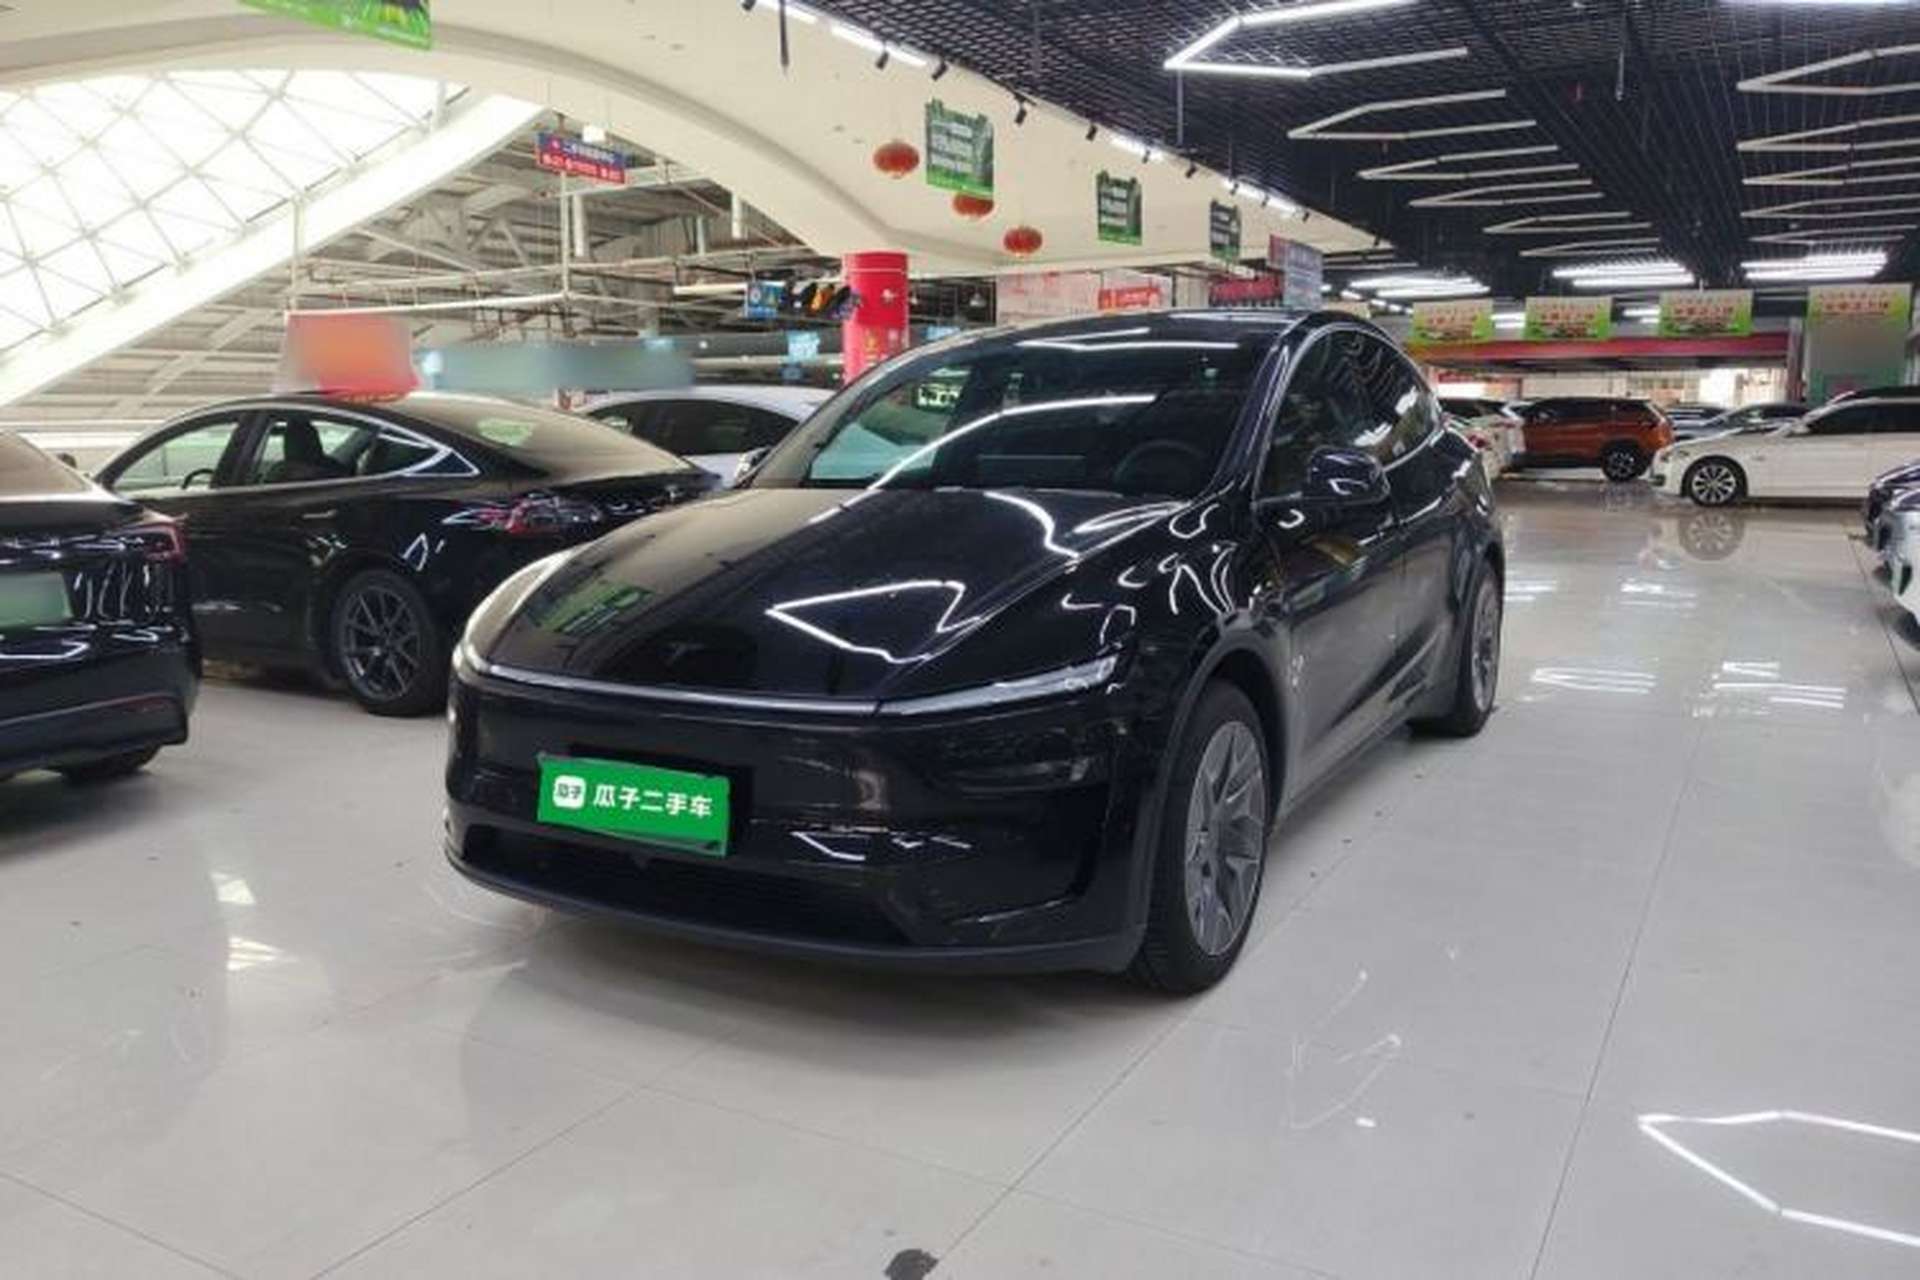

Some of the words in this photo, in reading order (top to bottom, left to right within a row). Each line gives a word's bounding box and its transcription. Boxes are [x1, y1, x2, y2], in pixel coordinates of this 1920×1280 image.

[594, 784, 712, 818] 瓜子二手车
